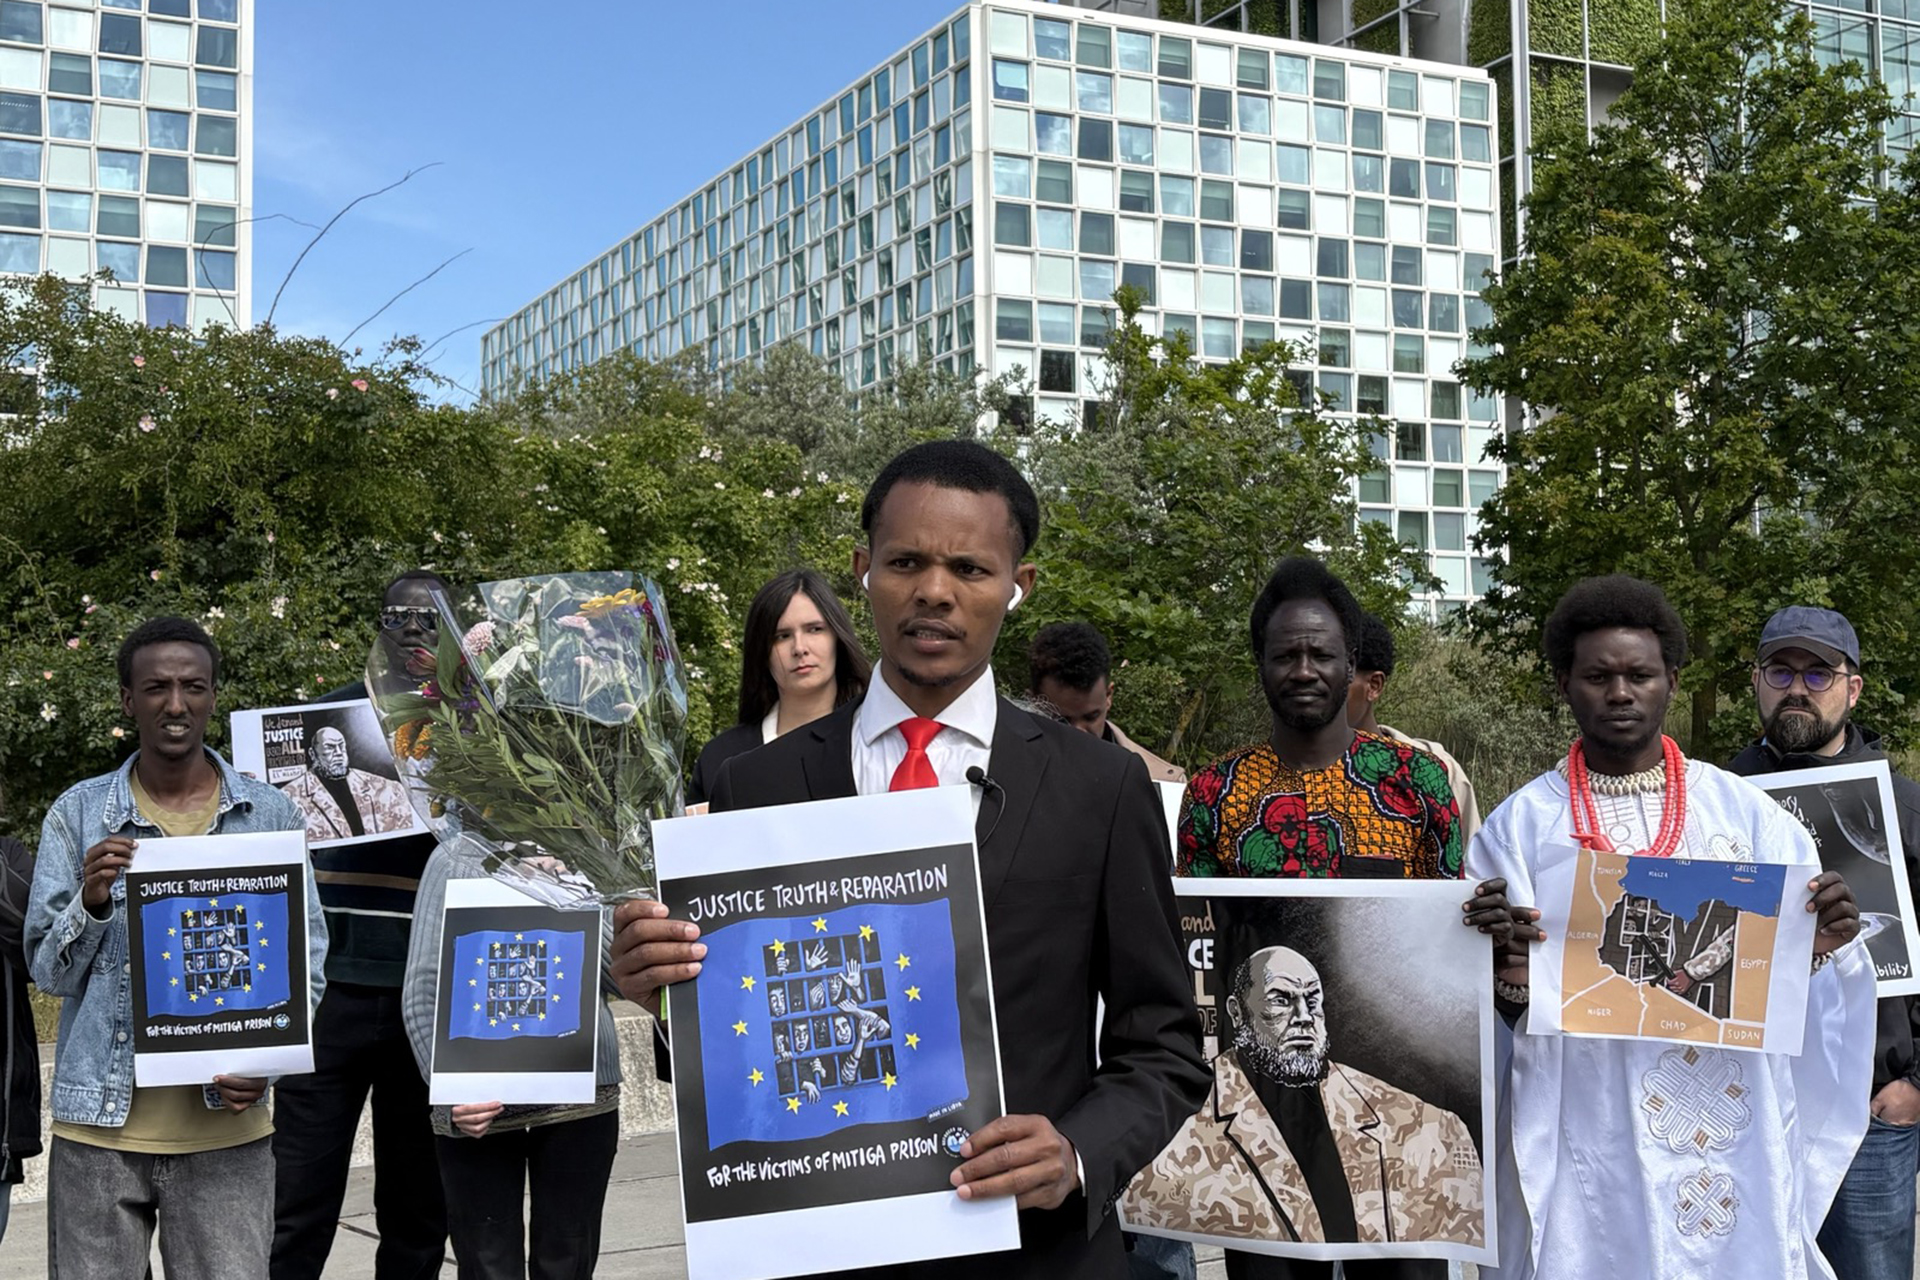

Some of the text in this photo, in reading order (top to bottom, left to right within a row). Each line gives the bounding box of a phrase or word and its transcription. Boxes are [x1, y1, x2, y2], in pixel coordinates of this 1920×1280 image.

[264, 727, 304, 743] JUSTICE
[282, 740, 305, 755] ALL
[1734, 865, 1758, 874] GREECE
[140, 880, 185, 897] JUSTICE
[187, 878, 219, 893] TRUTH
[226, 873, 288, 893] REPARATION
[688, 889, 765, 922] JUSTICE
[772, 880, 828, 909] TRUTH
[840, 863, 949, 903] REPARATION
[1740, 959, 1768, 970] EGYPT
[1587, 1008, 1611, 1016] NIGER
[146, 1024, 160, 1038] FOR
[159, 1024, 173, 1036] THE
[212, 1020, 243, 1034] MITIGA
[244, 1016, 272, 1030] PRISON
[1660, 1020, 1686, 1031] CHAD
[1727, 1028, 1761, 1040] SUDAN
[706, 1164, 731, 1188] FOR
[732, 1160, 757, 1182] THE
[815, 1151, 831, 1172] OF
[832, 1144, 886, 1170] MITIGA
[890, 1133, 938, 1161] PRISON
